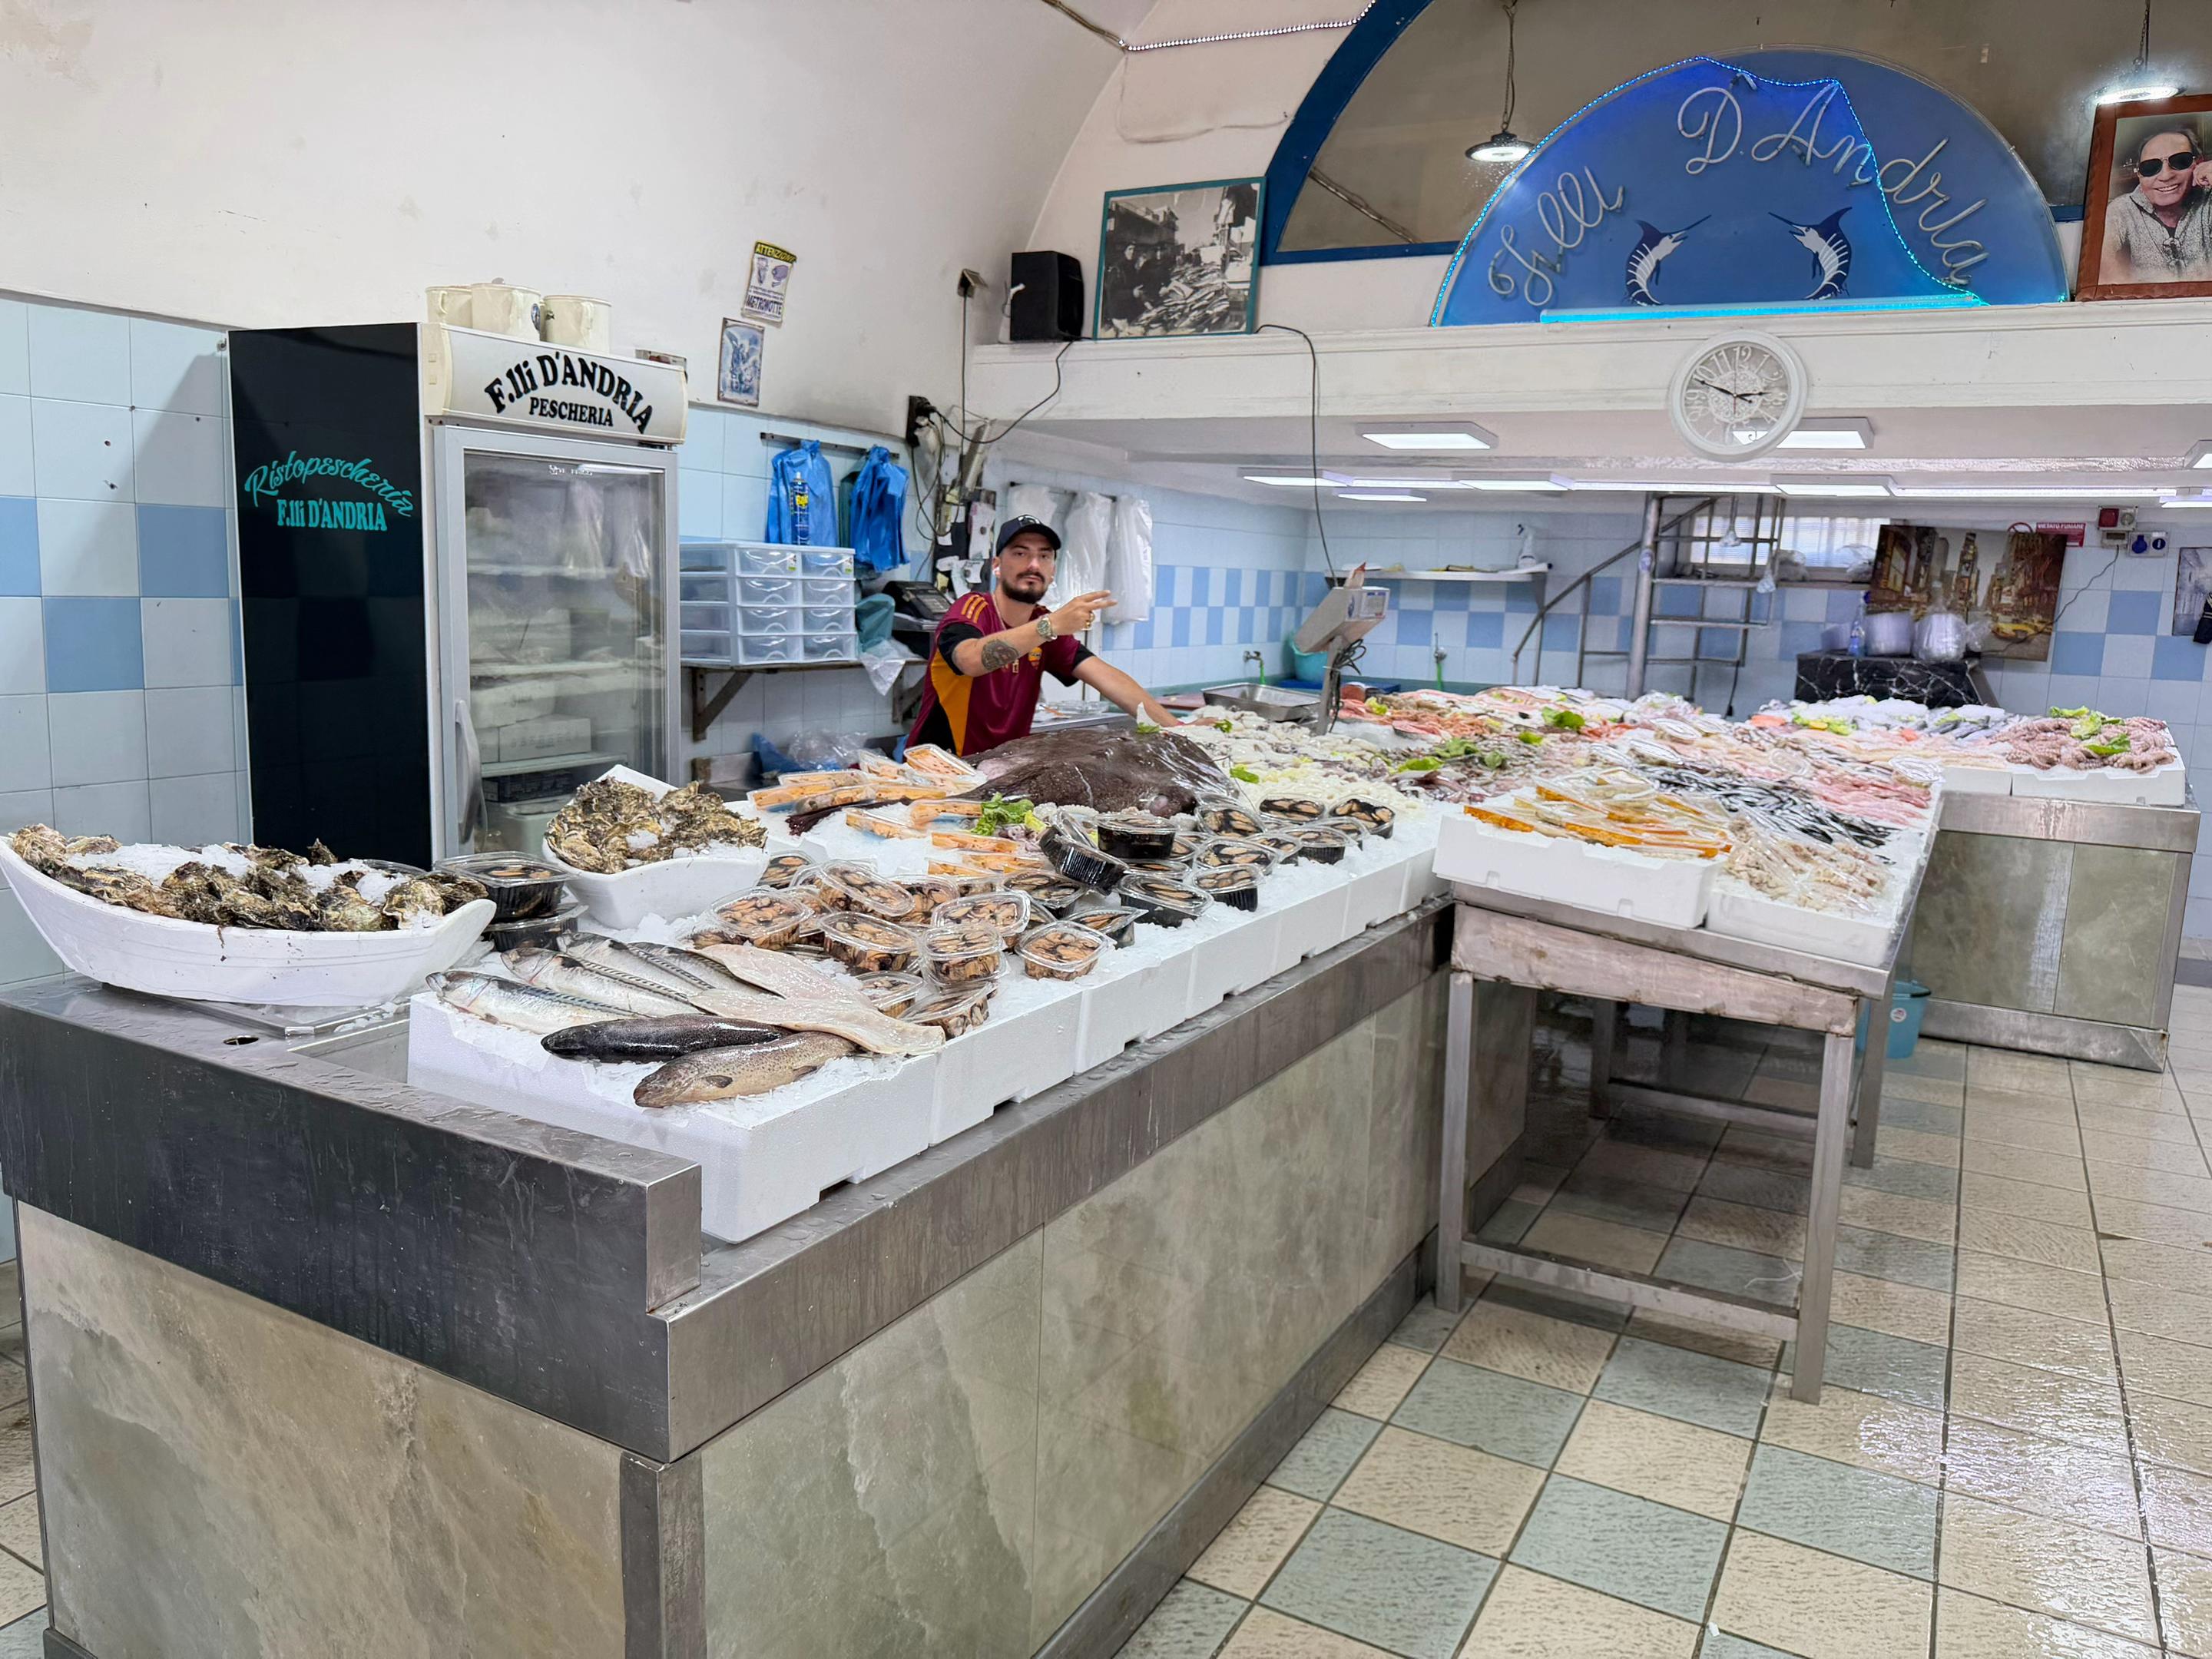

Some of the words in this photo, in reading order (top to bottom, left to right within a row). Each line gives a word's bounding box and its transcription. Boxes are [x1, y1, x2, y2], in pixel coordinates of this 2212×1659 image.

[1710, 349, 1733, 375] 11
[484, 360, 538, 414] F.lli
[536, 351, 653, 434] D'ANDRIA
[529, 396, 614, 427] PESCHERIA
[244, 450, 413, 518] Ristopescheria
[277, 499, 306, 527] F.lli
[308, 498, 388, 531] D'ANDRIA
